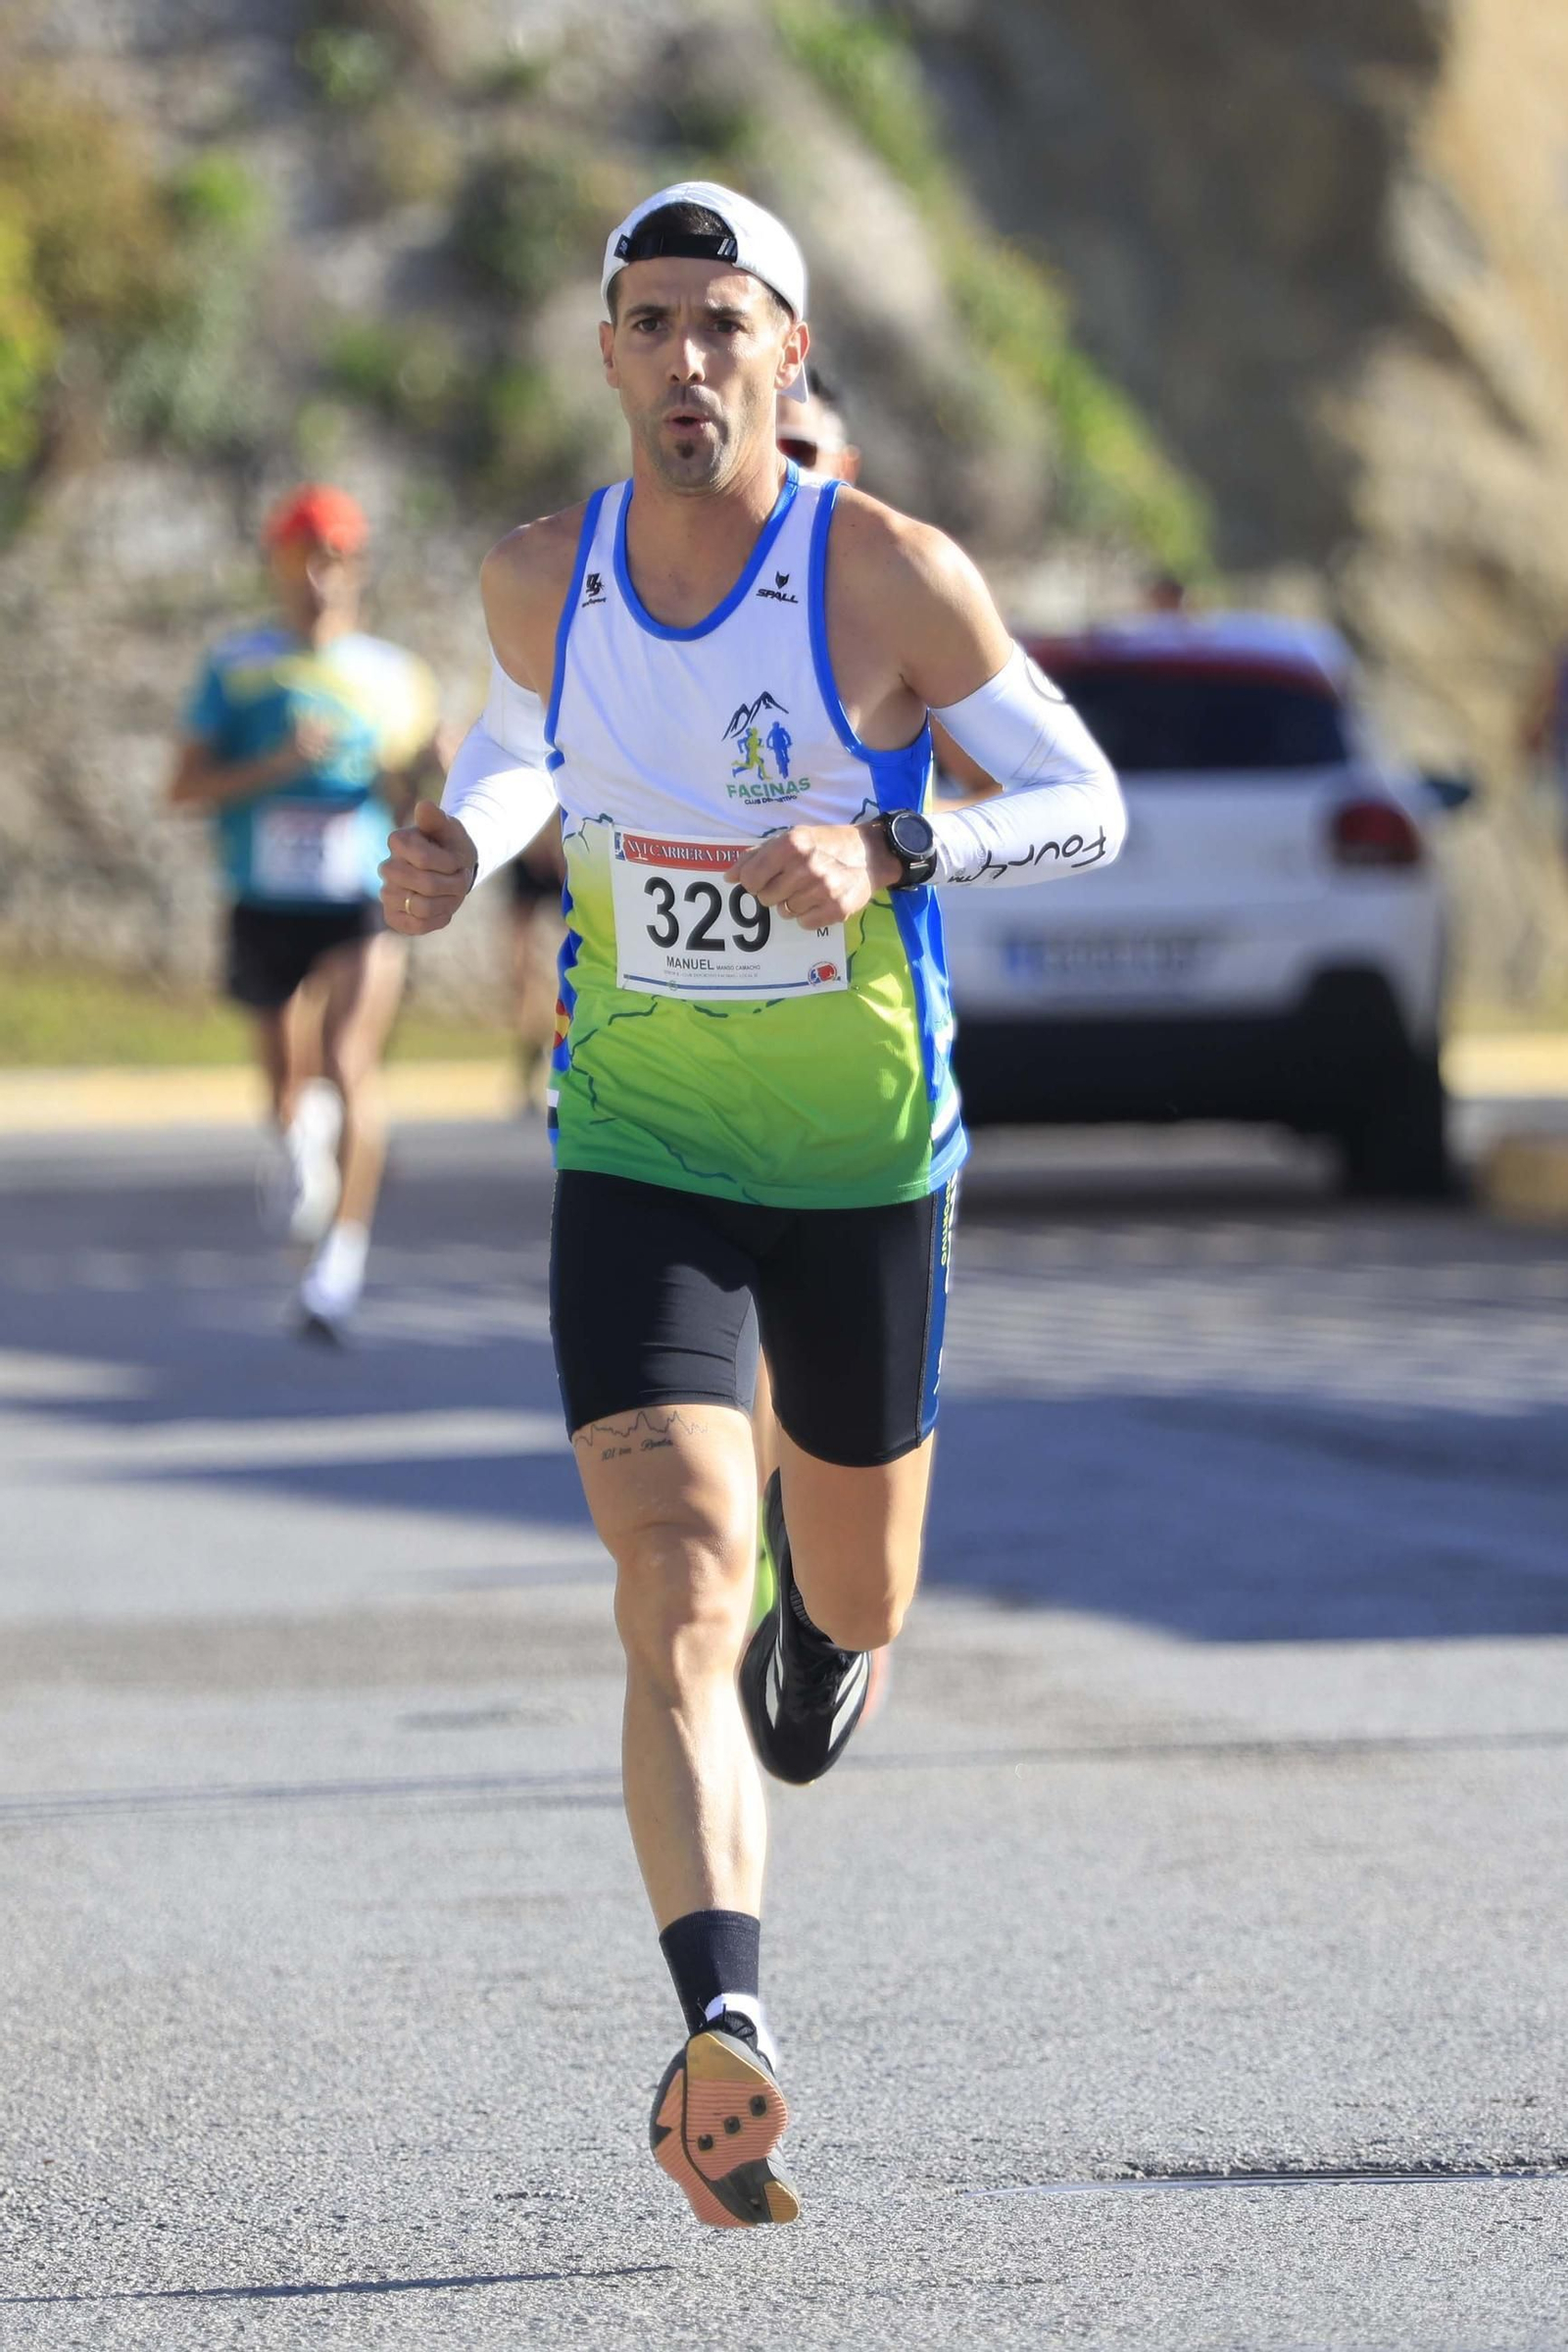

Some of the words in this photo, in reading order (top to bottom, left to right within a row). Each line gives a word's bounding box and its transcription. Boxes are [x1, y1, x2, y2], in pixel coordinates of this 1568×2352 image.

[756, 588, 799, 604] SPALL
[726, 777, 810, 799] FACINAS
[649, 844, 713, 862] CARRERA
[643, 876, 771, 953] 329
[816, 926, 829, 938] M
[666, 956, 714, 970] MANUEL
